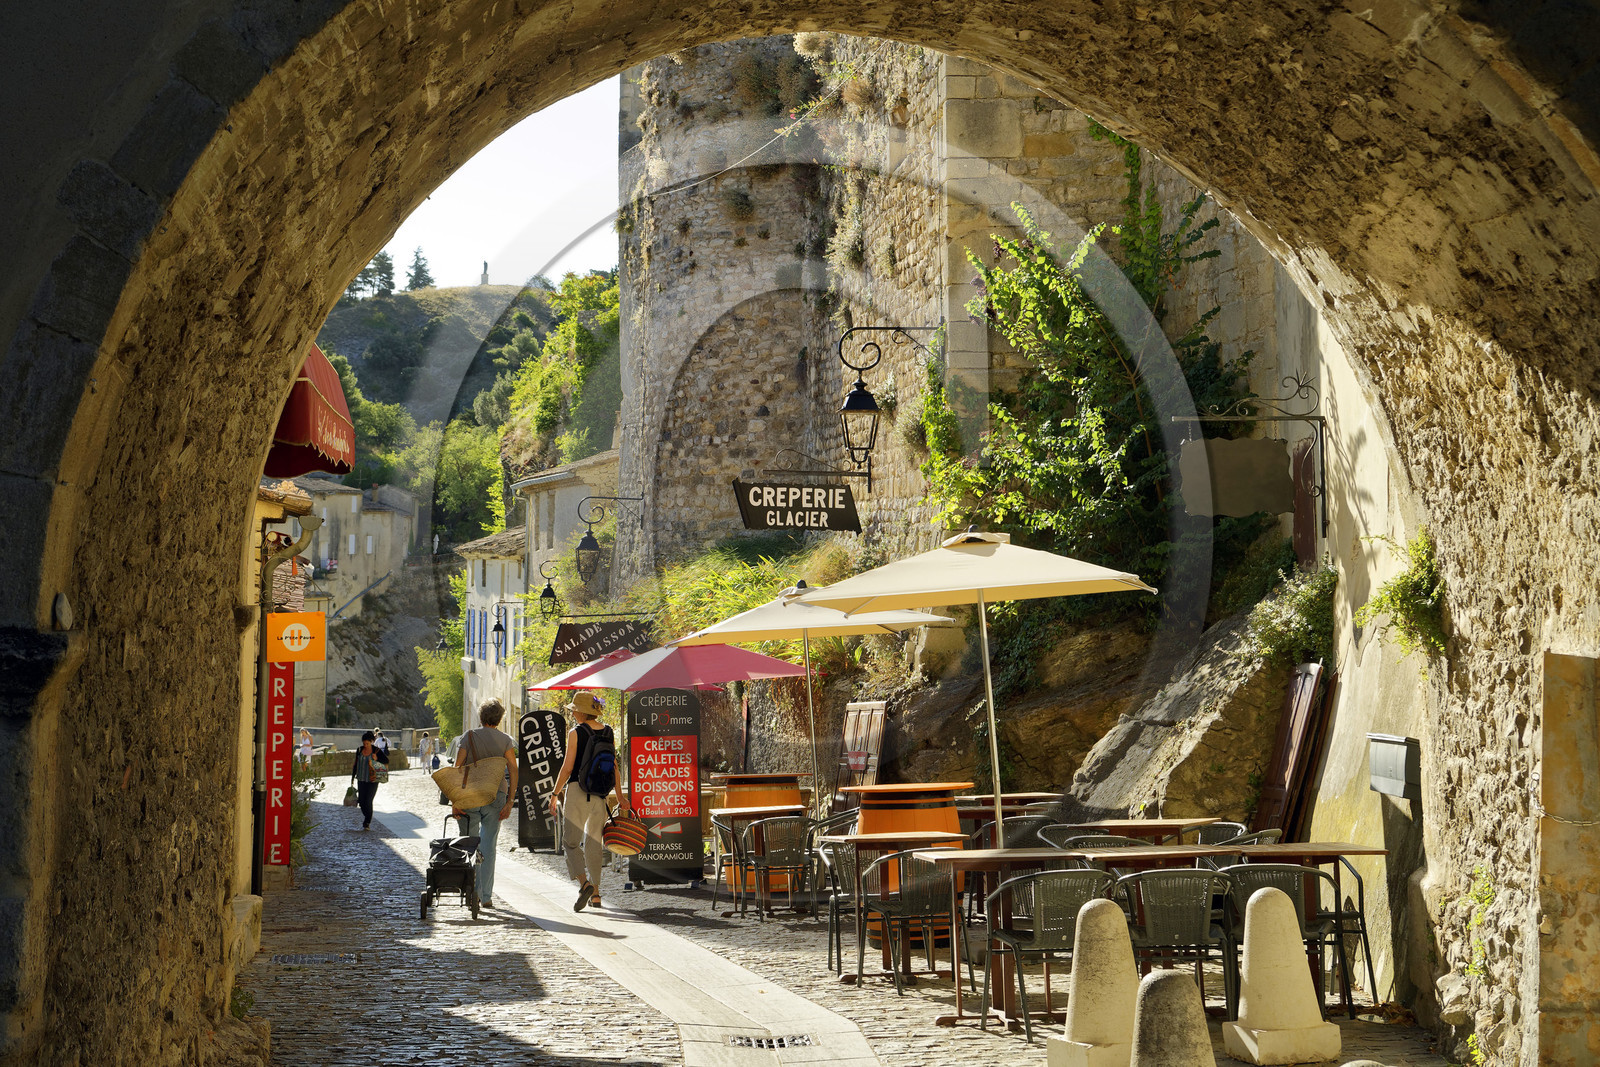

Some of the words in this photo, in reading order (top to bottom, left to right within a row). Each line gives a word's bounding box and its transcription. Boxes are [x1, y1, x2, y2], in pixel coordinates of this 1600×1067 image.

[749, 486, 846, 509] CREPERIE
[766, 510, 829, 527] GLACIER
[555, 622, 602, 657] SALADE
[640, 693, 687, 707] CRÊPERIE
[635, 713, 646, 725] La
[545, 714, 563, 760] BOISSONS
[644, 737, 684, 751] CRÊPES
[636, 753, 692, 765] GALETTES
[638, 767, 690, 778] SALADES
[635, 780, 694, 793] BOISSONS
[522, 785, 536, 821] GLACES
[642, 794, 687, 806] GLACES
[649, 843, 682, 851] TERRASSE
[638, 852, 694, 861] PANORAMIQUE
